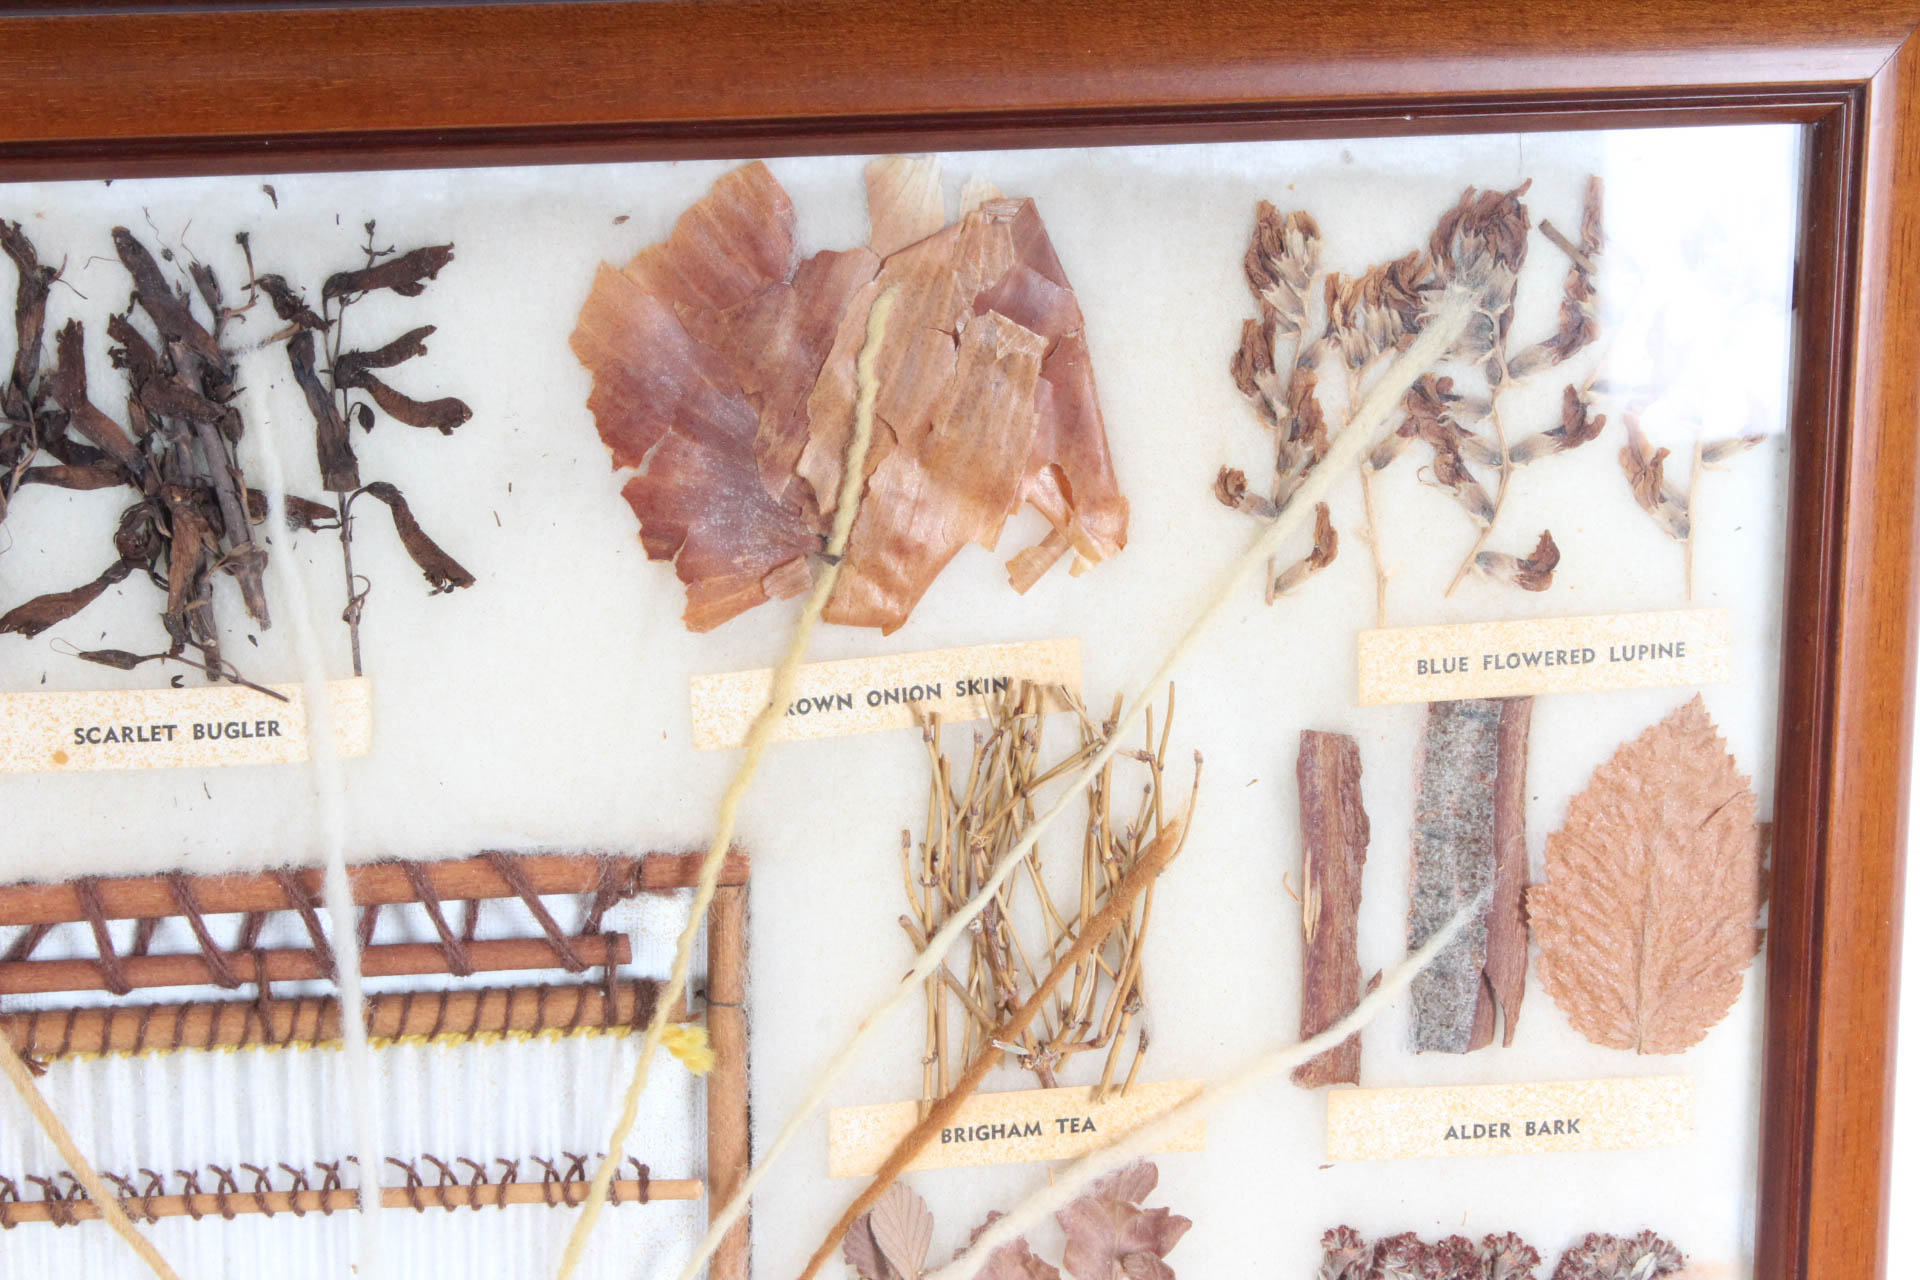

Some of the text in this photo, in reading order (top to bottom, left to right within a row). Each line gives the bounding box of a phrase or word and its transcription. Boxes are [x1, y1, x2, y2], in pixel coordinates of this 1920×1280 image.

[1417, 641, 1686, 675] BLUE FLOWERED LUPINE
[769, 676, 1008, 717] OWN ONION SKIN
[74, 720, 282, 745] SCARLET BUGLER
[941, 1117, 1097, 1144] BRIGHAM TEA
[1443, 1118, 1581, 1141] ALDER BARK
